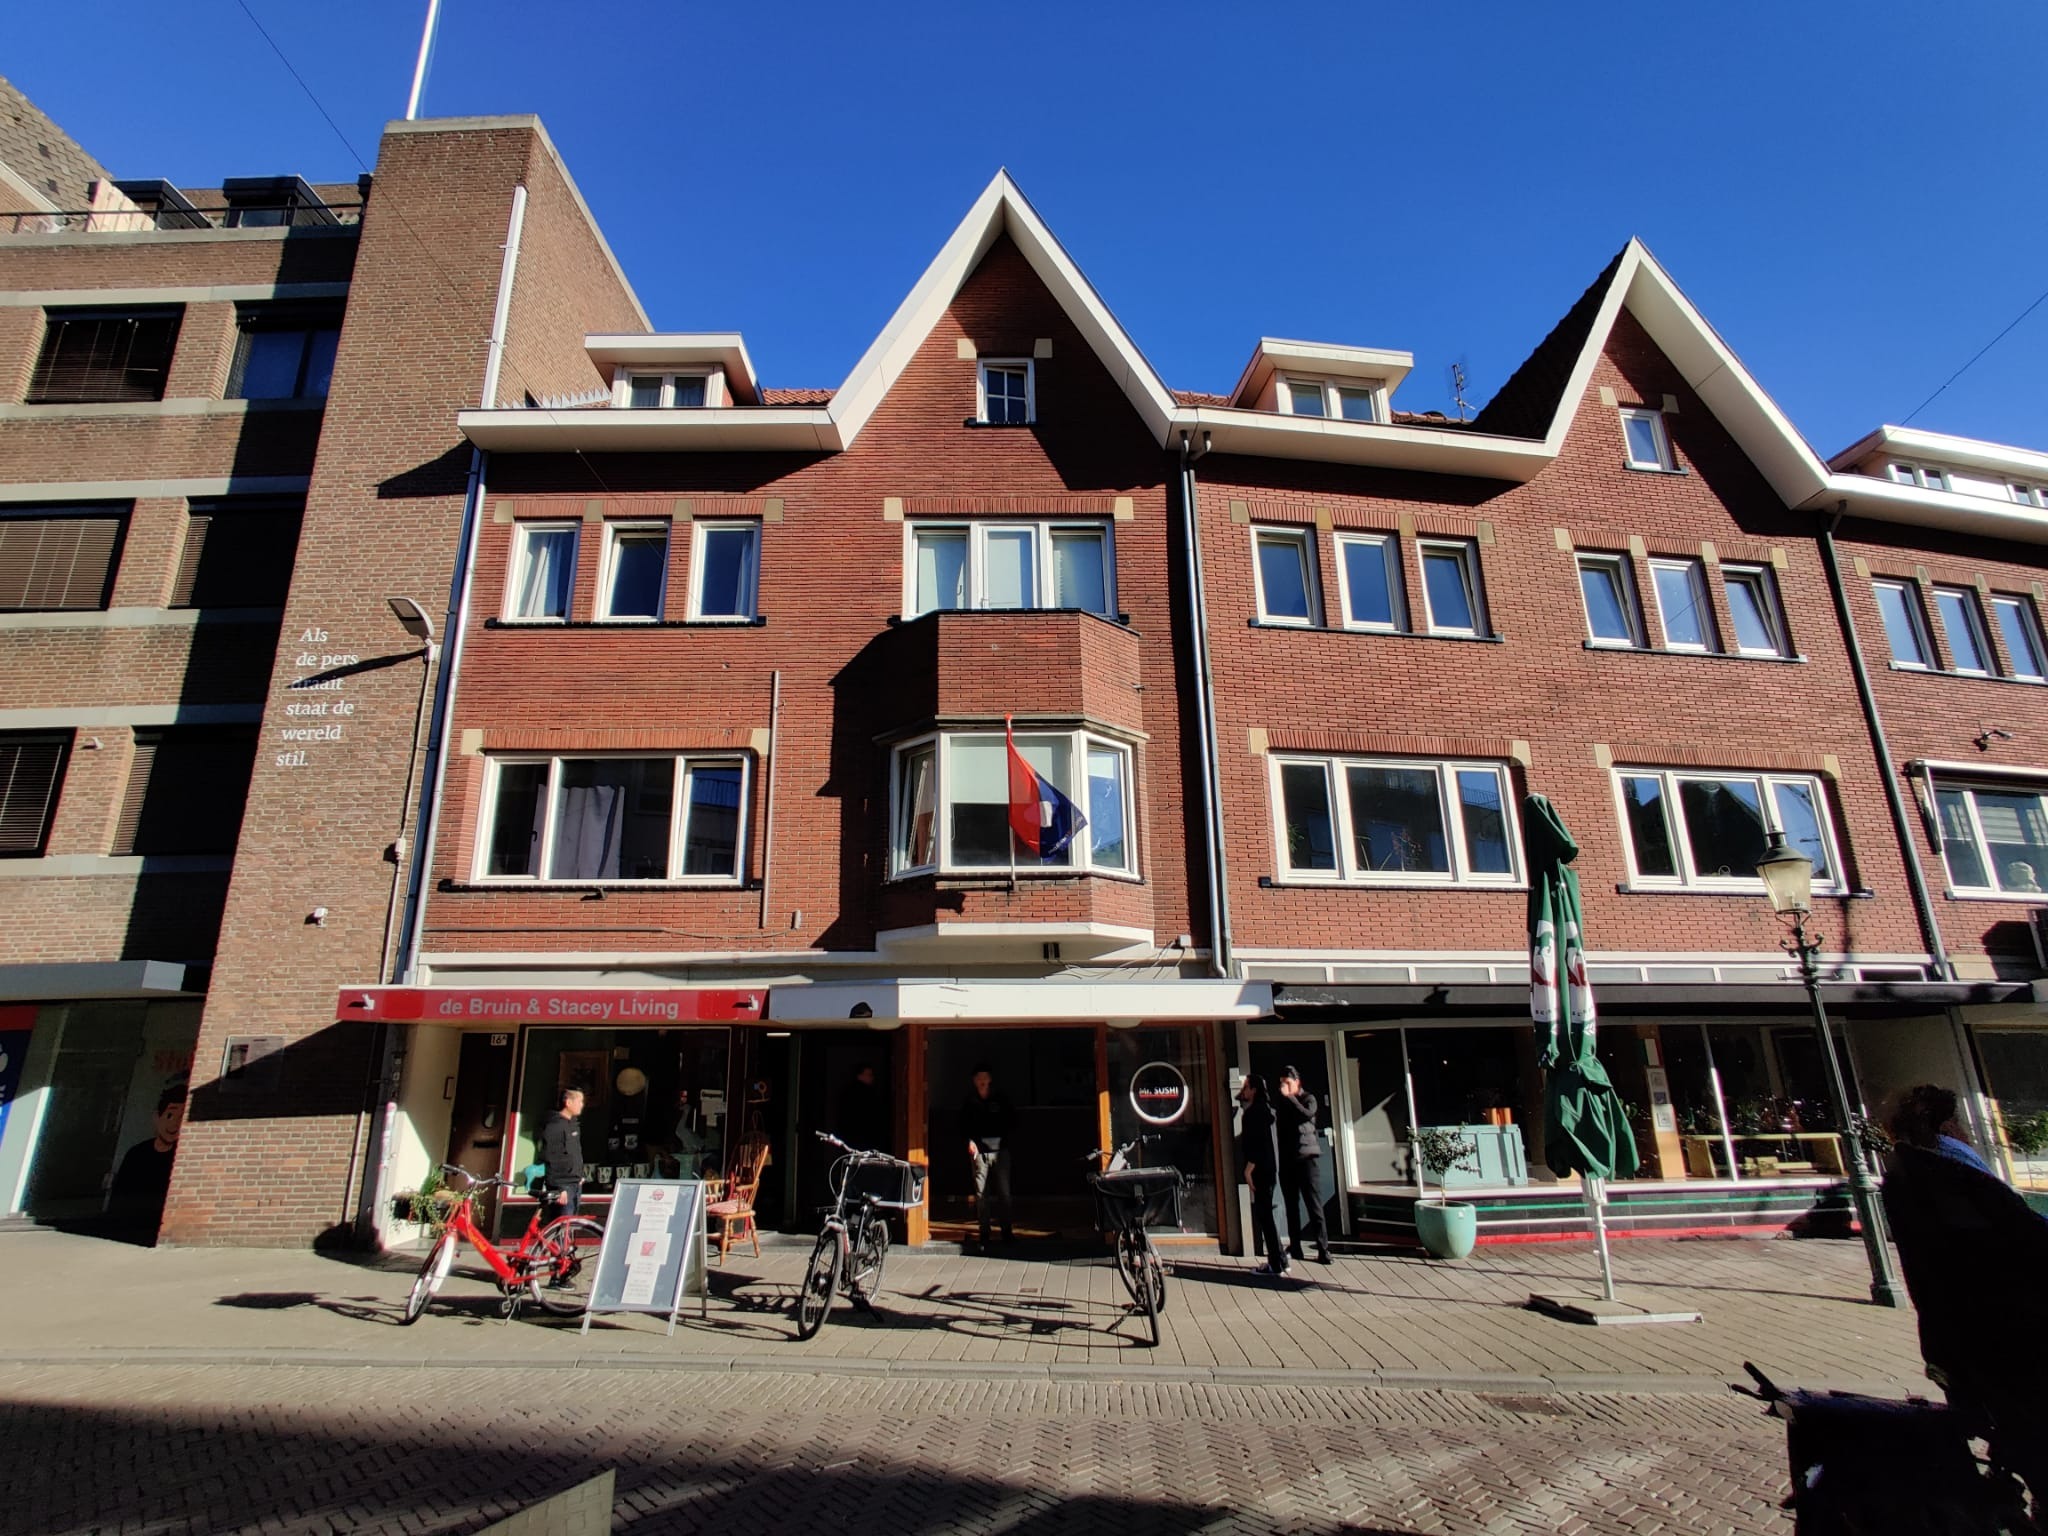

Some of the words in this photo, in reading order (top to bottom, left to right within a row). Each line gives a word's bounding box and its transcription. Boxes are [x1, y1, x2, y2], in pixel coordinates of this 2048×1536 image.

[299, 628, 329, 643] Als
[296, 652, 316, 667] de
[320, 653, 359, 670] pers
[290, 676, 344, 691] draait
[285, 701, 328, 716] staat
[332, 700, 355, 715] de
[281, 725, 342, 741] wereld
[275, 751, 309, 767] stil.
[439, 998, 463, 1015] de
[468, 998, 521, 1015] Bruin
[526, 998, 541, 1015] &
[547, 998, 614, 1019] Stacey
[618, 998, 680, 1020] Living
[1153, 1086, 1179, 1096] SUSHI
